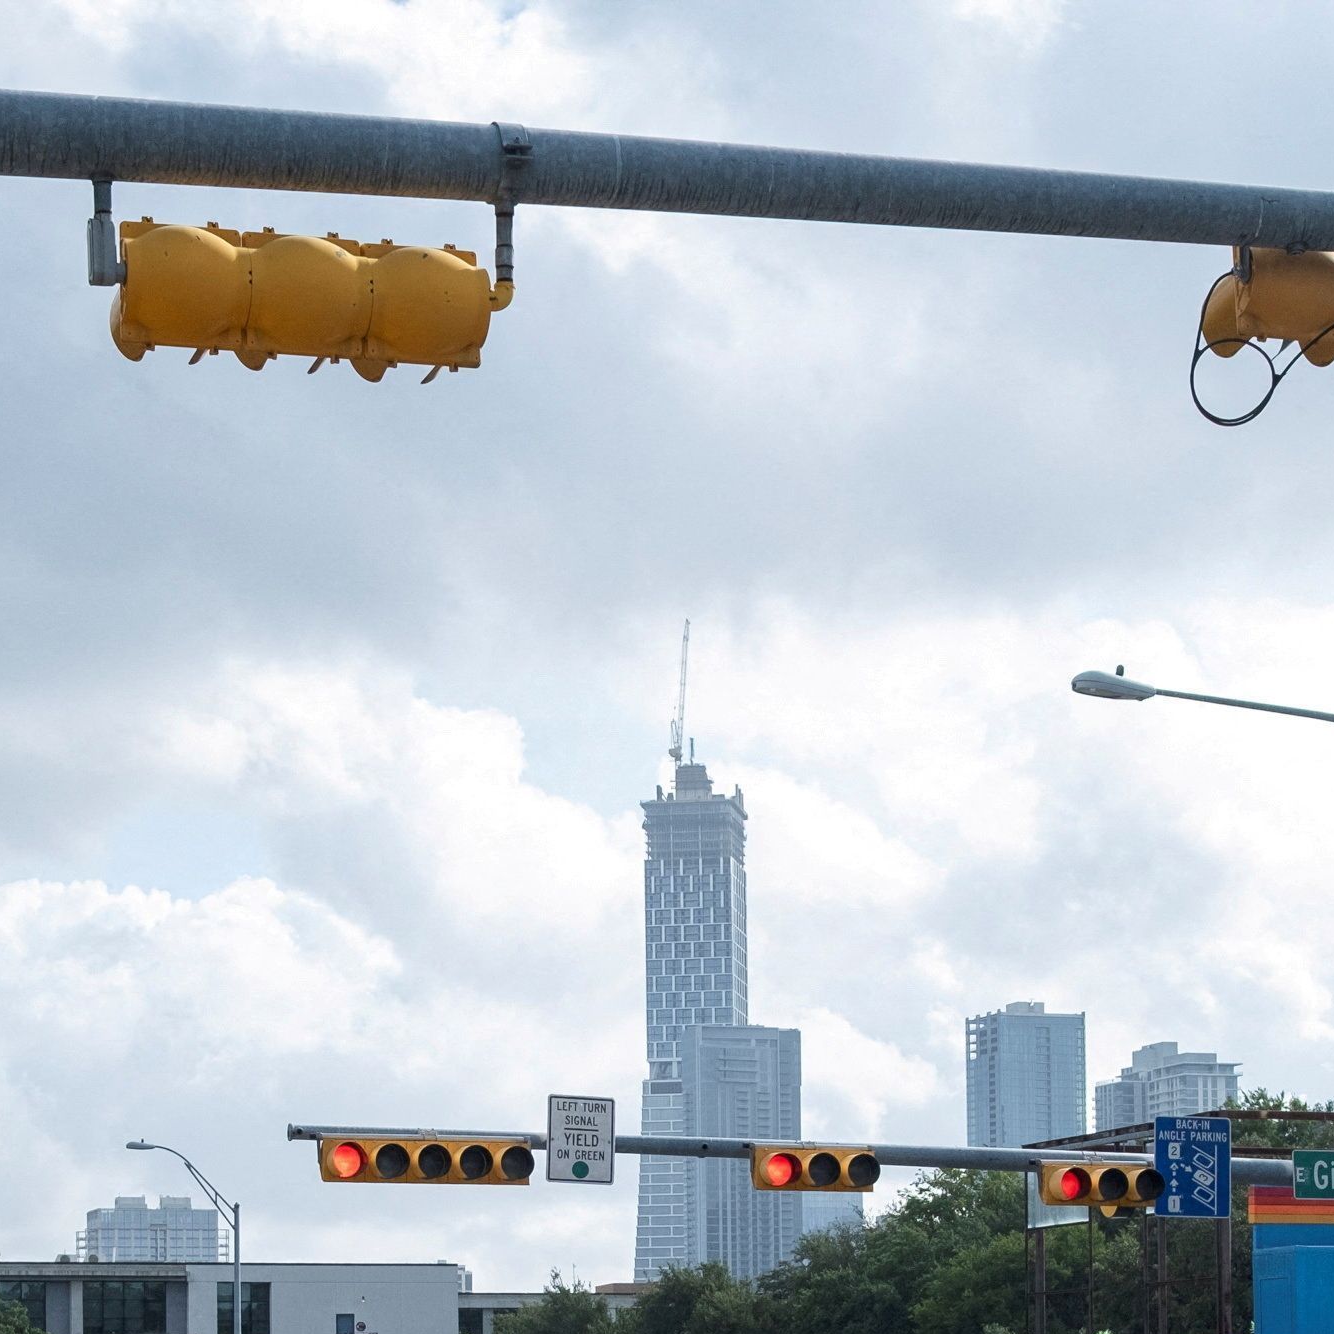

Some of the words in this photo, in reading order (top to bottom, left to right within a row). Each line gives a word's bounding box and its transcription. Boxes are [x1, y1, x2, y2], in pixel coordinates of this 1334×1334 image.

[557, 1101, 578, 1112] LEFT
[583, 1102, 607, 1113] TURN
[564, 1115, 598, 1127] SIGNAL
[1175, 1119, 1210, 1130] BACK-IN
[563, 1132, 599, 1147] YIELD
[1158, 1130, 1186, 1141] ANGLE
[1190, 1131, 1227, 1142] PARKING
[556, 1148, 570, 1159] ON
[574, 1149, 605, 1161] GREEN
[1170, 1145, 1178, 1156] 2
[1296, 1167, 1306, 1183] E
